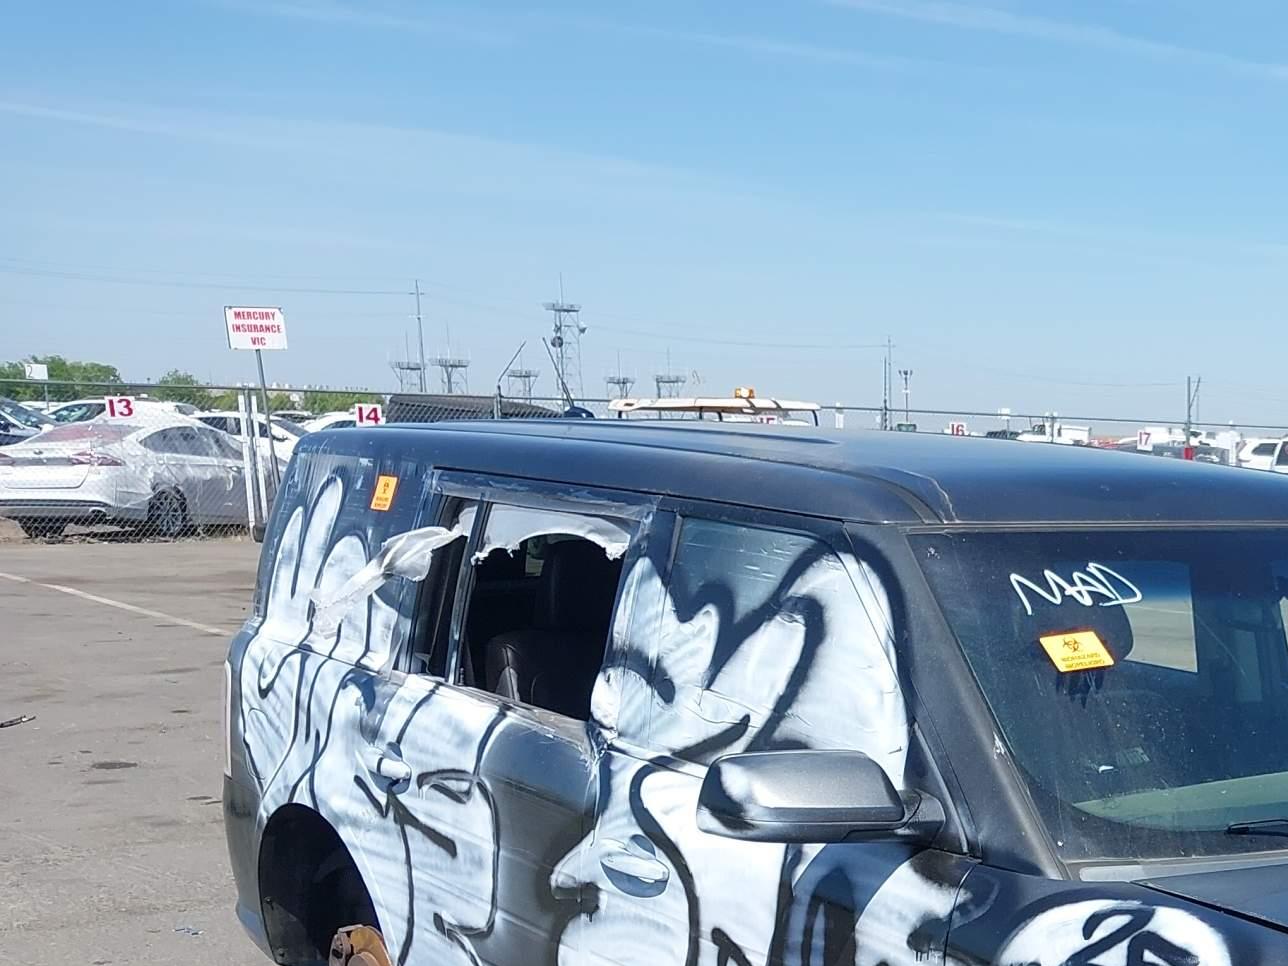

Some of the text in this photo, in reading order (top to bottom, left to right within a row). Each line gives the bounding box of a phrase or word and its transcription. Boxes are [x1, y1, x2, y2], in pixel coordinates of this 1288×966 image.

[233, 311, 275, 321] MERCURY
[232, 324, 281, 334] INSURANCE
[250, 336, 266, 346] VIC
[108, 399, 133, 417] 13
[358, 406, 380, 424] 14
[951, 424, 965, 436] 16
[1139, 432, 1151, 446] 17
